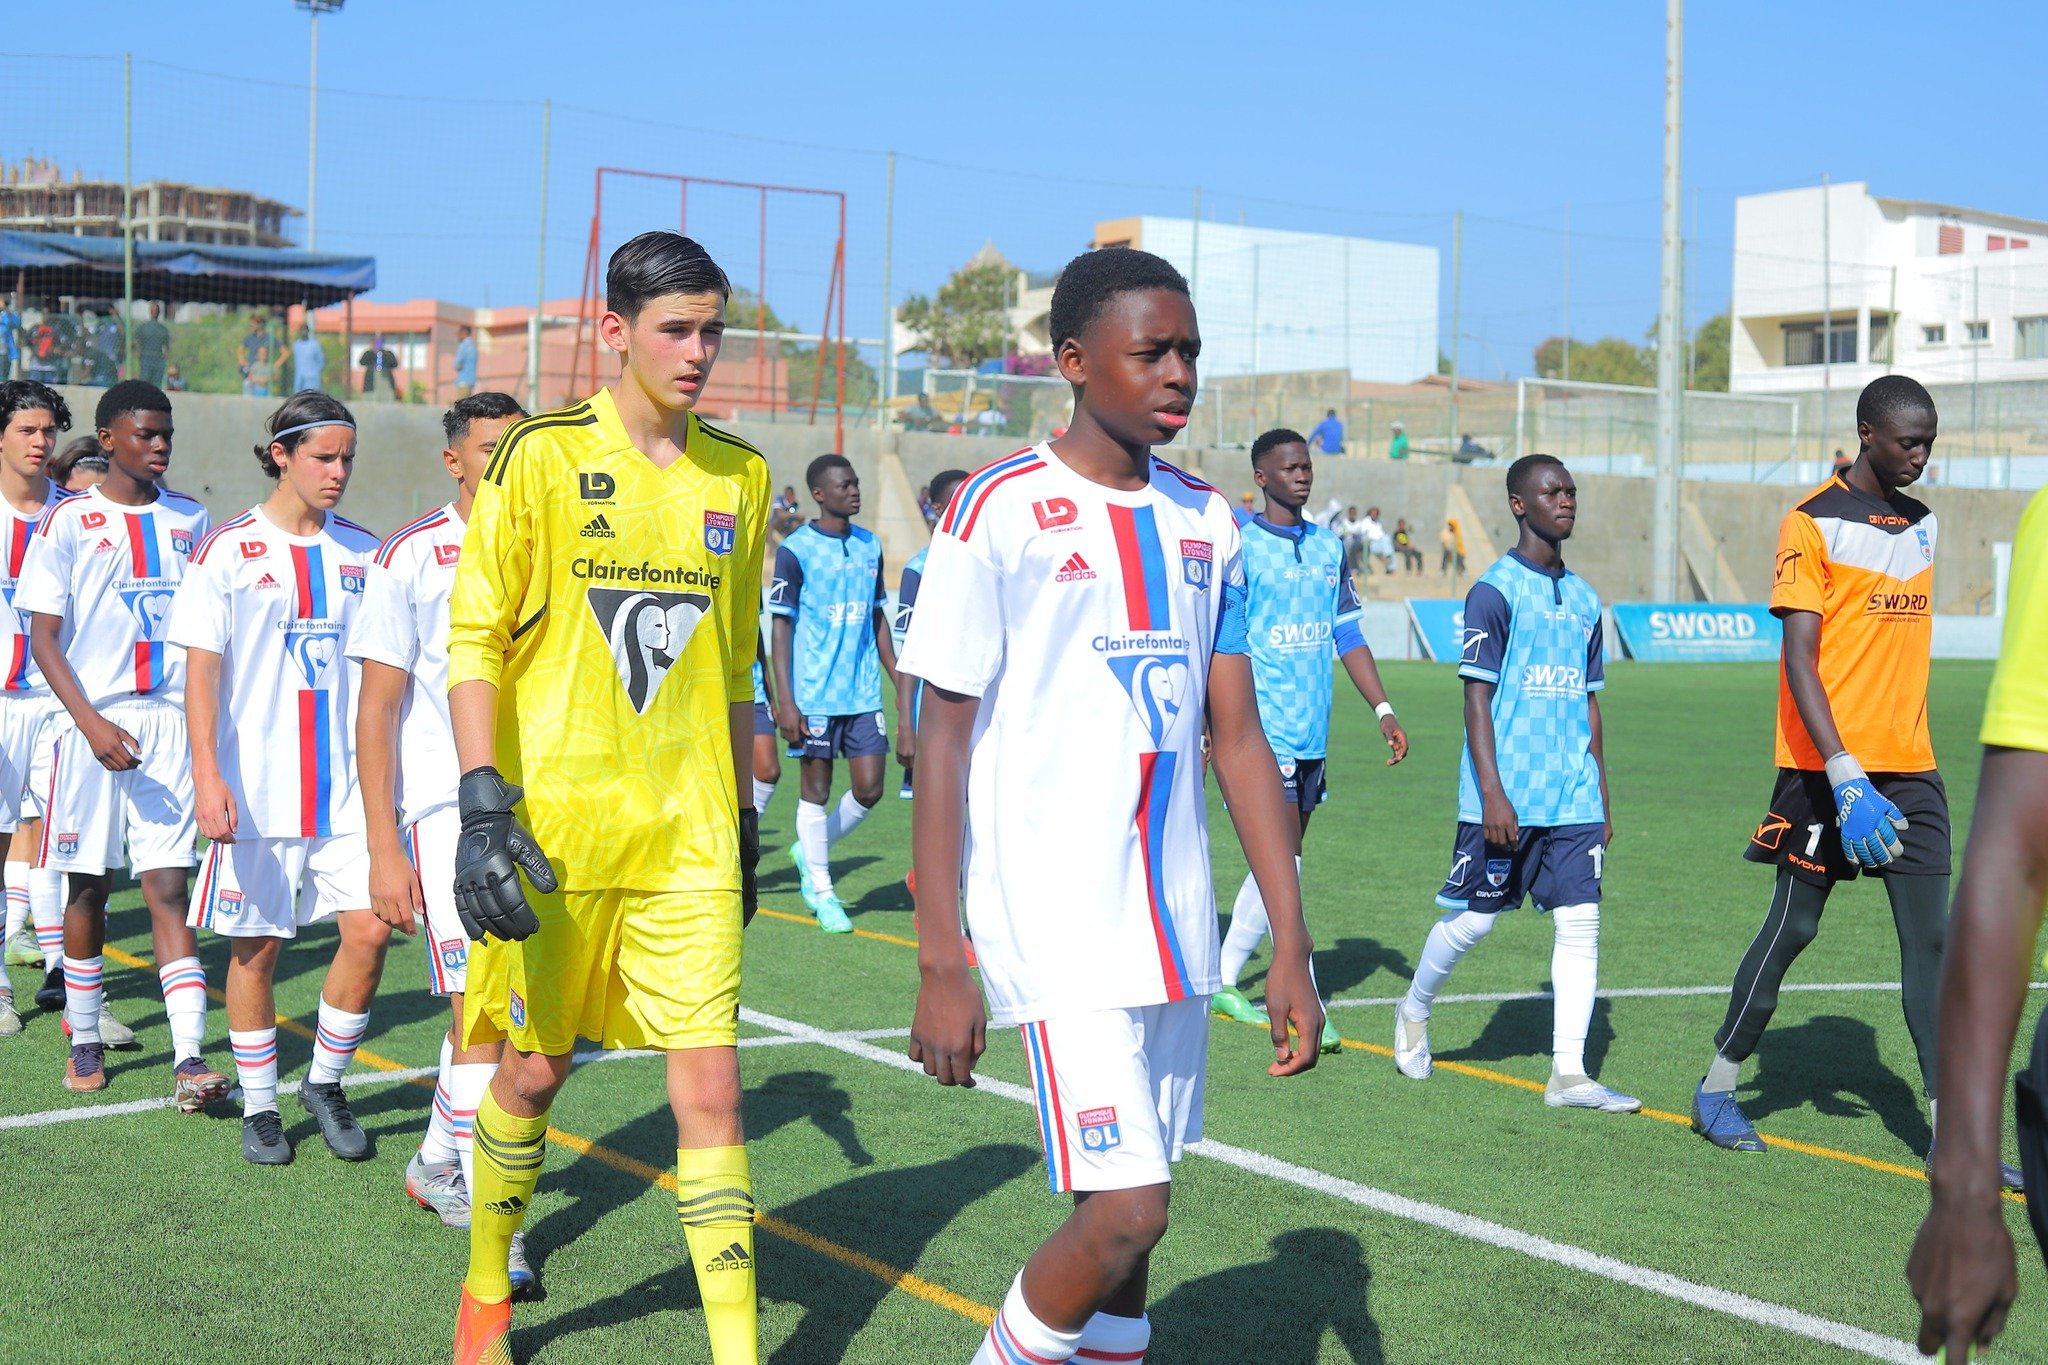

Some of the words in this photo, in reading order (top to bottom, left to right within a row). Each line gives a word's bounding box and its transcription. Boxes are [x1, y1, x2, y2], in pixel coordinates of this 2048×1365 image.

[706, 513, 735, 521] OLYMPIQUE
[1869, 514, 1910, 526] GIVOVA
[706, 519, 734, 528] LYONNAIS
[580, 529, 616, 538] adidas
[1055, 569, 1096, 582] adidas
[255, 582, 281, 590] adidas
[1867, 594, 1928, 610] SWORD
[277, 620, 346, 630] Clairefontaine
[1649, 611, 1757, 639] SWORD
[1092, 633, 1190, 651] Clairefontae
[1804, 823, 1824, 857] 1
[445, 951, 466, 966] OL
[1080, 1114, 1115, 1125] LYONNAIS
[1085, 1125, 1118, 1148] OL
[485, 1203, 528, 1215] adidas
[706, 1260, 753, 1272] adidas
